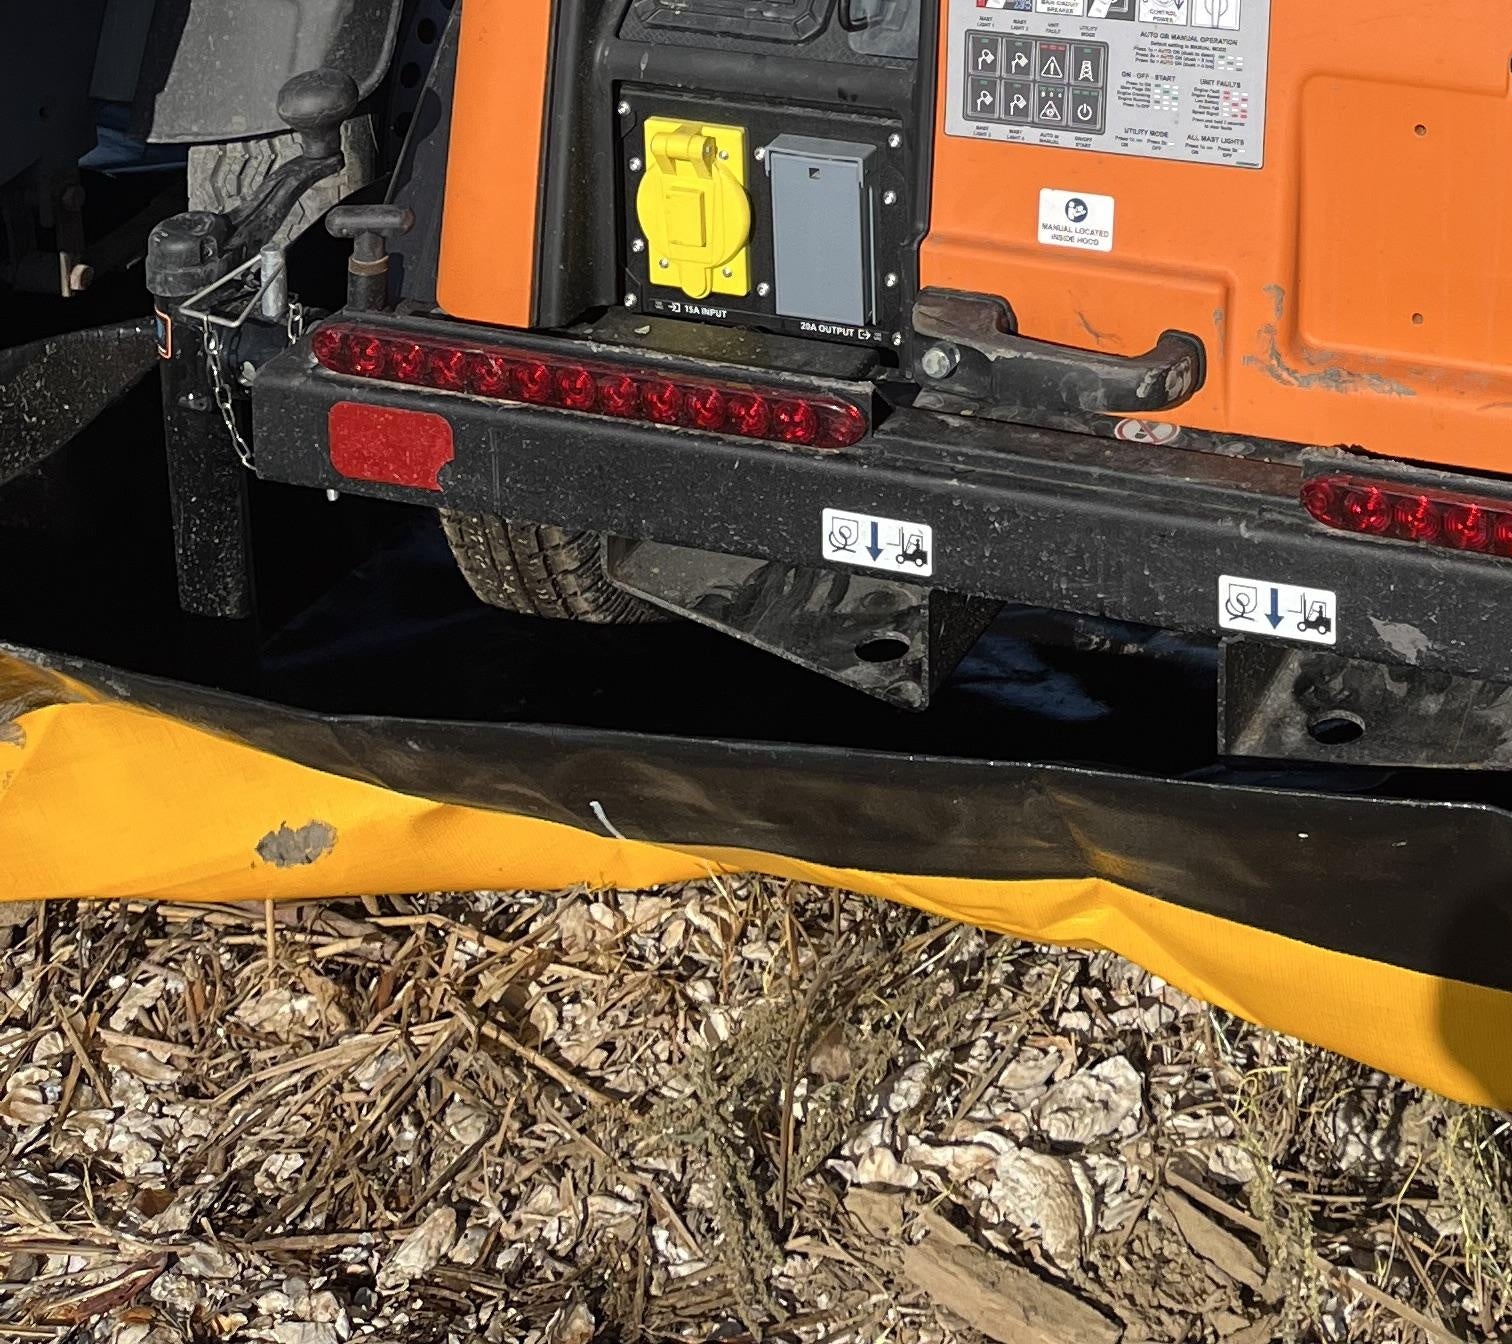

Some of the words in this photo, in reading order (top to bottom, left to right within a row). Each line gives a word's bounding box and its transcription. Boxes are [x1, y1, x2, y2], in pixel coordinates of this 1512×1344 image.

[684, 305, 700, 314] 15A
[701, 307, 727, 318] INPUT
[800, 322, 817, 332] 20A
[819, 325, 854, 337] OUTPUT
